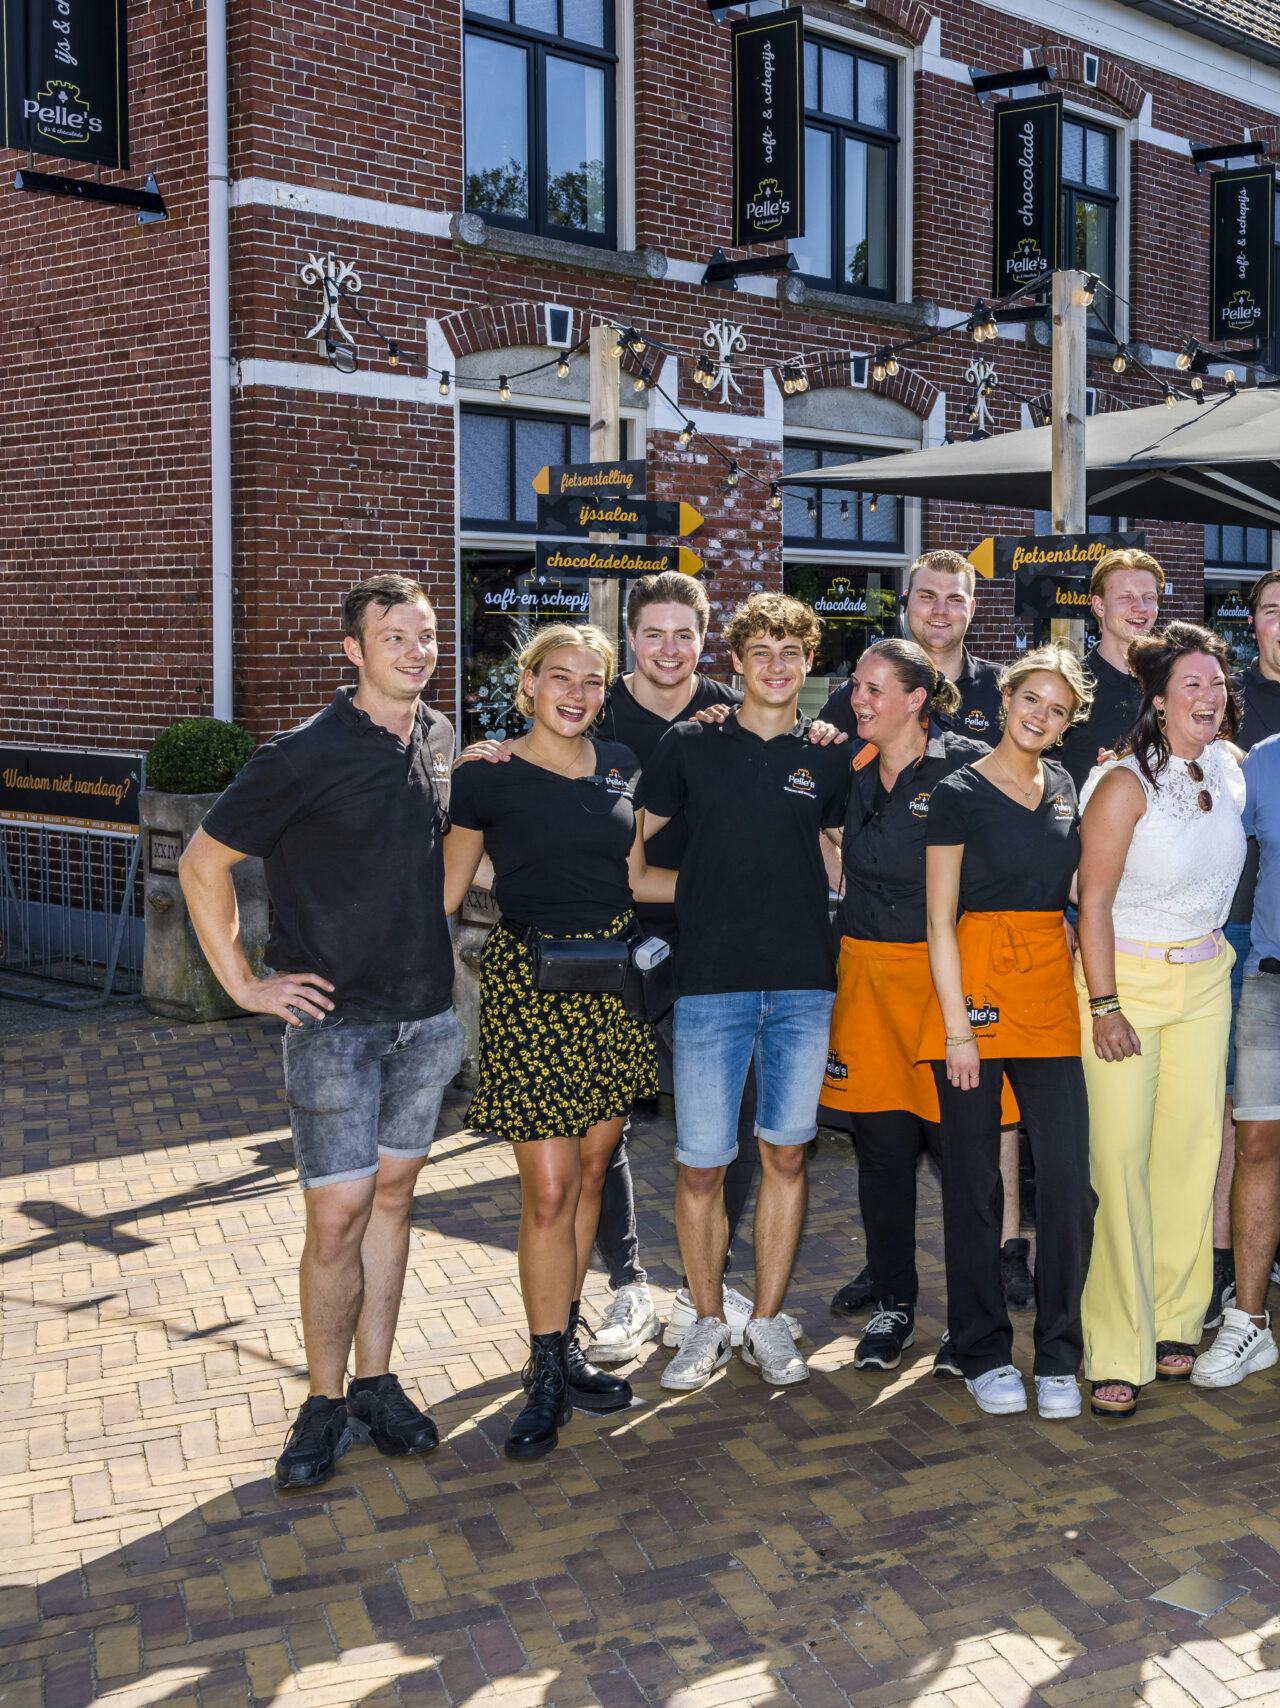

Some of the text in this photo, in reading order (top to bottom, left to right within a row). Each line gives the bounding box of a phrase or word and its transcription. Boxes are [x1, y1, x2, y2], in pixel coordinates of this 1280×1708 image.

[52, 19, 70, 34] &
[54, 38, 78, 66] ijs
[761, 40, 775, 105] schepijs
[24, 99, 103, 132] Pelle's
[763, 109, 773, 120] &
[1018, 121, 1034, 226] chocolade
[746, 198, 790, 219] Pelle's
[1237, 187, 1250, 235] schepijs
[1237, 238, 1246, 247] &
[1006, 256, 1048, 273] Pelle's
[1222, 305, 1261, 320] Pelle's
[560, 469, 634, 493] fietsenstalling
[579, 504, 639, 525] ijssalon
[546, 551, 668, 571] chocoladelokaal
[540, 589, 590, 612] schepij
[814, 596, 867, 611] chocolade
[2, 768, 131, 806] Waarom niet vandaag?
[788, 774, 815, 789] Pelle's
[153, 842, 179, 860] XXIV
